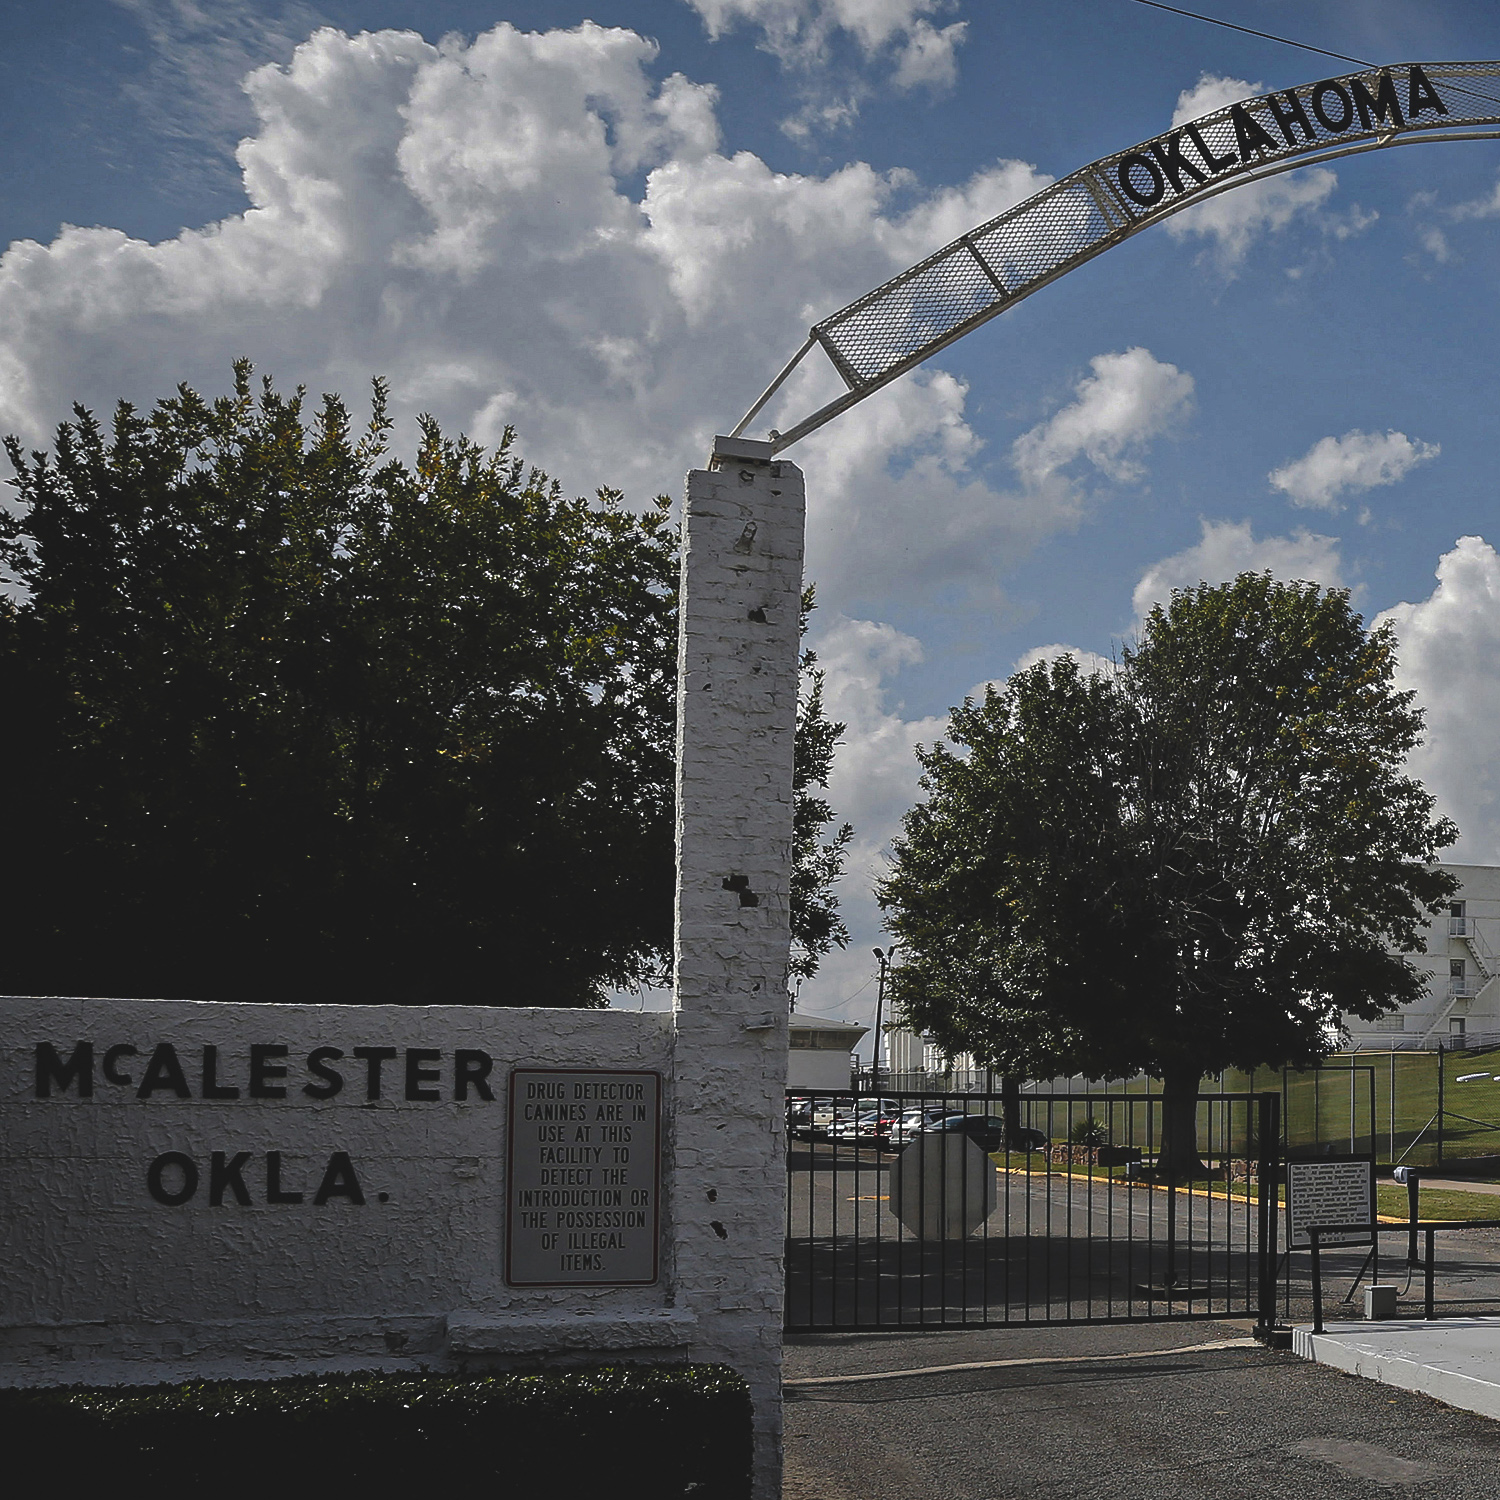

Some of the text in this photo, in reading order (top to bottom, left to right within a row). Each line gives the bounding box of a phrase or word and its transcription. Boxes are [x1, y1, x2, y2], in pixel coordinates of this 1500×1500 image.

[1118, 66, 1449, 206] OKLAHOMA
[35, 1041, 495, 1102] McALESTER
[527, 1083, 644, 1100] DRUG DETECTOR
[524, 1104, 646, 1121] CANINES ARE IN
[538, 1125, 632, 1143] USE AT THIS
[540, 1147, 630, 1164] FACILITY TO
[147, 1151, 390, 1207] OKLA.
[541, 1168, 628, 1185] DETECT THE
[519, 1190, 649, 1207] INTRODUCTION OR
[522, 1211, 646, 1228] THE POSSESSION
[541, 1233, 625, 1250] OF ILLEGAL
[561, 1254, 606, 1271] ITEMS.
